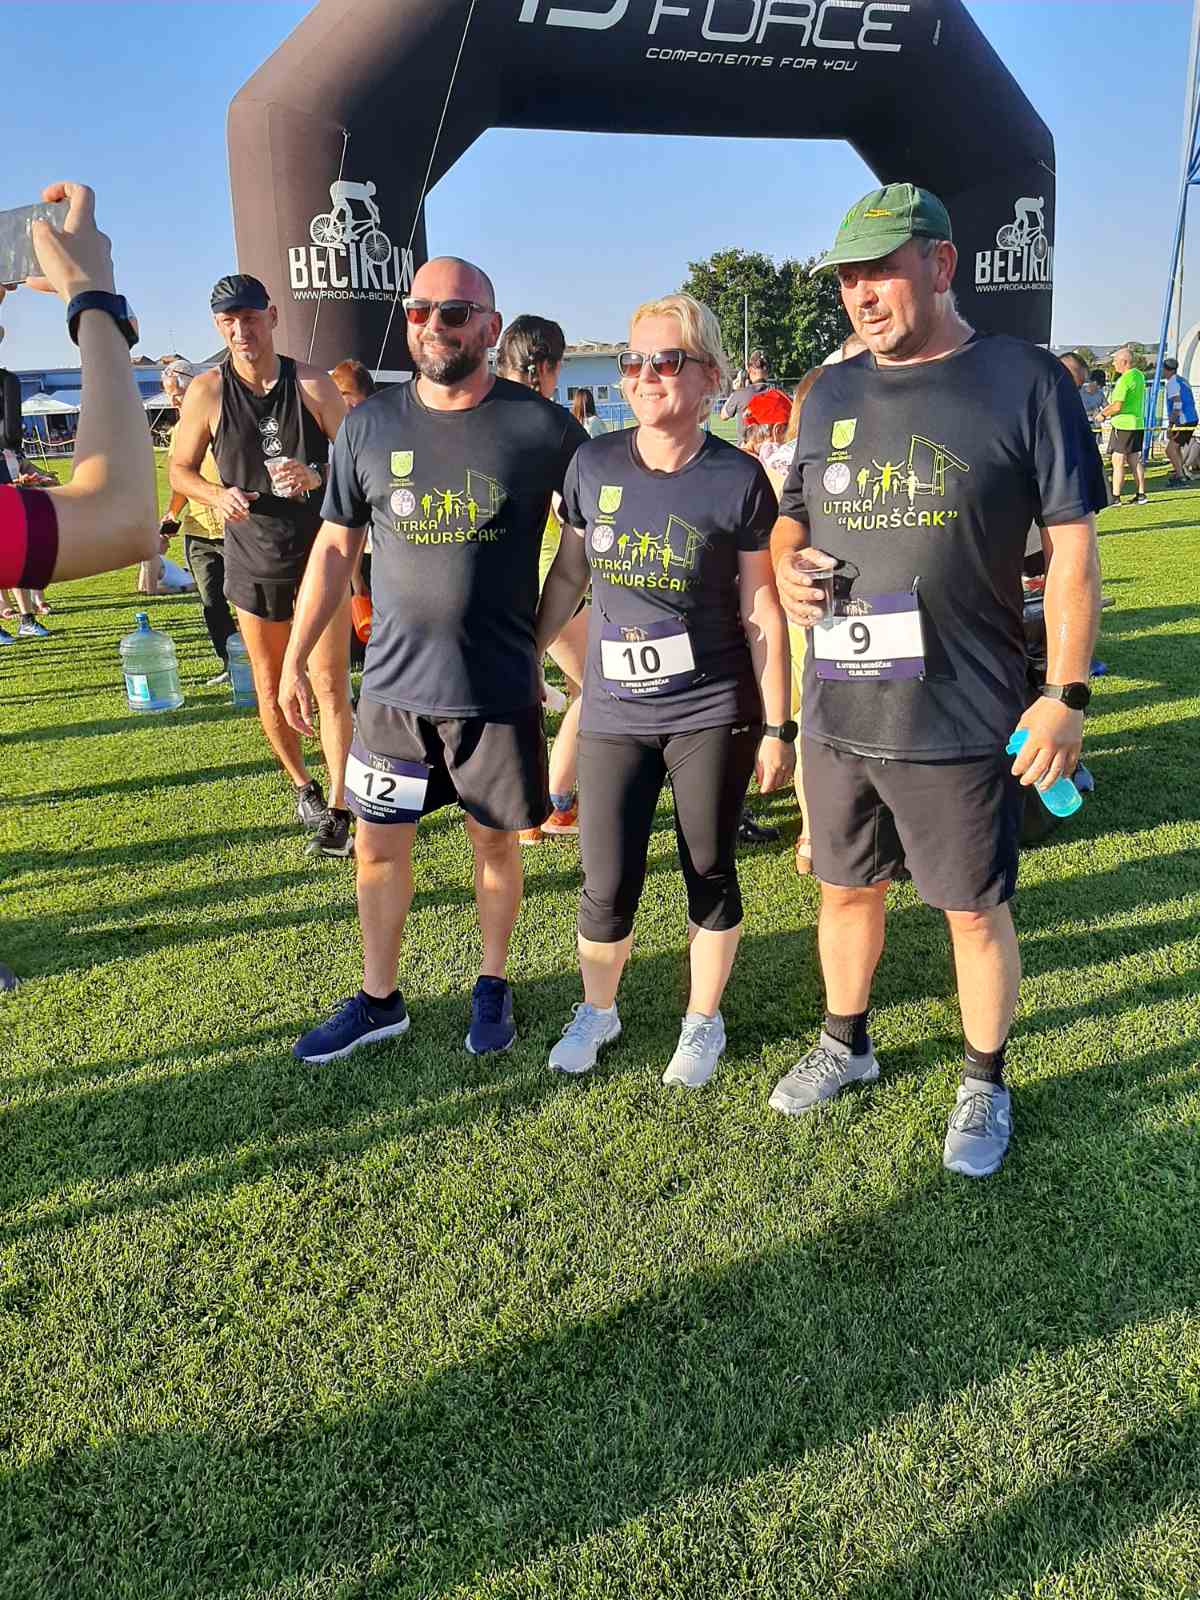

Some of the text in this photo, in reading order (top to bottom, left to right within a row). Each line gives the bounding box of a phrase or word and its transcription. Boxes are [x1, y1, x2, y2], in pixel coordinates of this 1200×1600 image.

[648, 0, 911, 52] FORCE
[646, 47, 859, 72] COMPONENTS FOR YOU
[823, 499, 873, 514] UTRKA
[393, 519, 438, 532] UTRKA
[591, 557, 632, 571] UTRKA
[849, 622, 871, 655] 9
[622, 645, 660, 675] 10
[364, 772, 397, 803] 12
